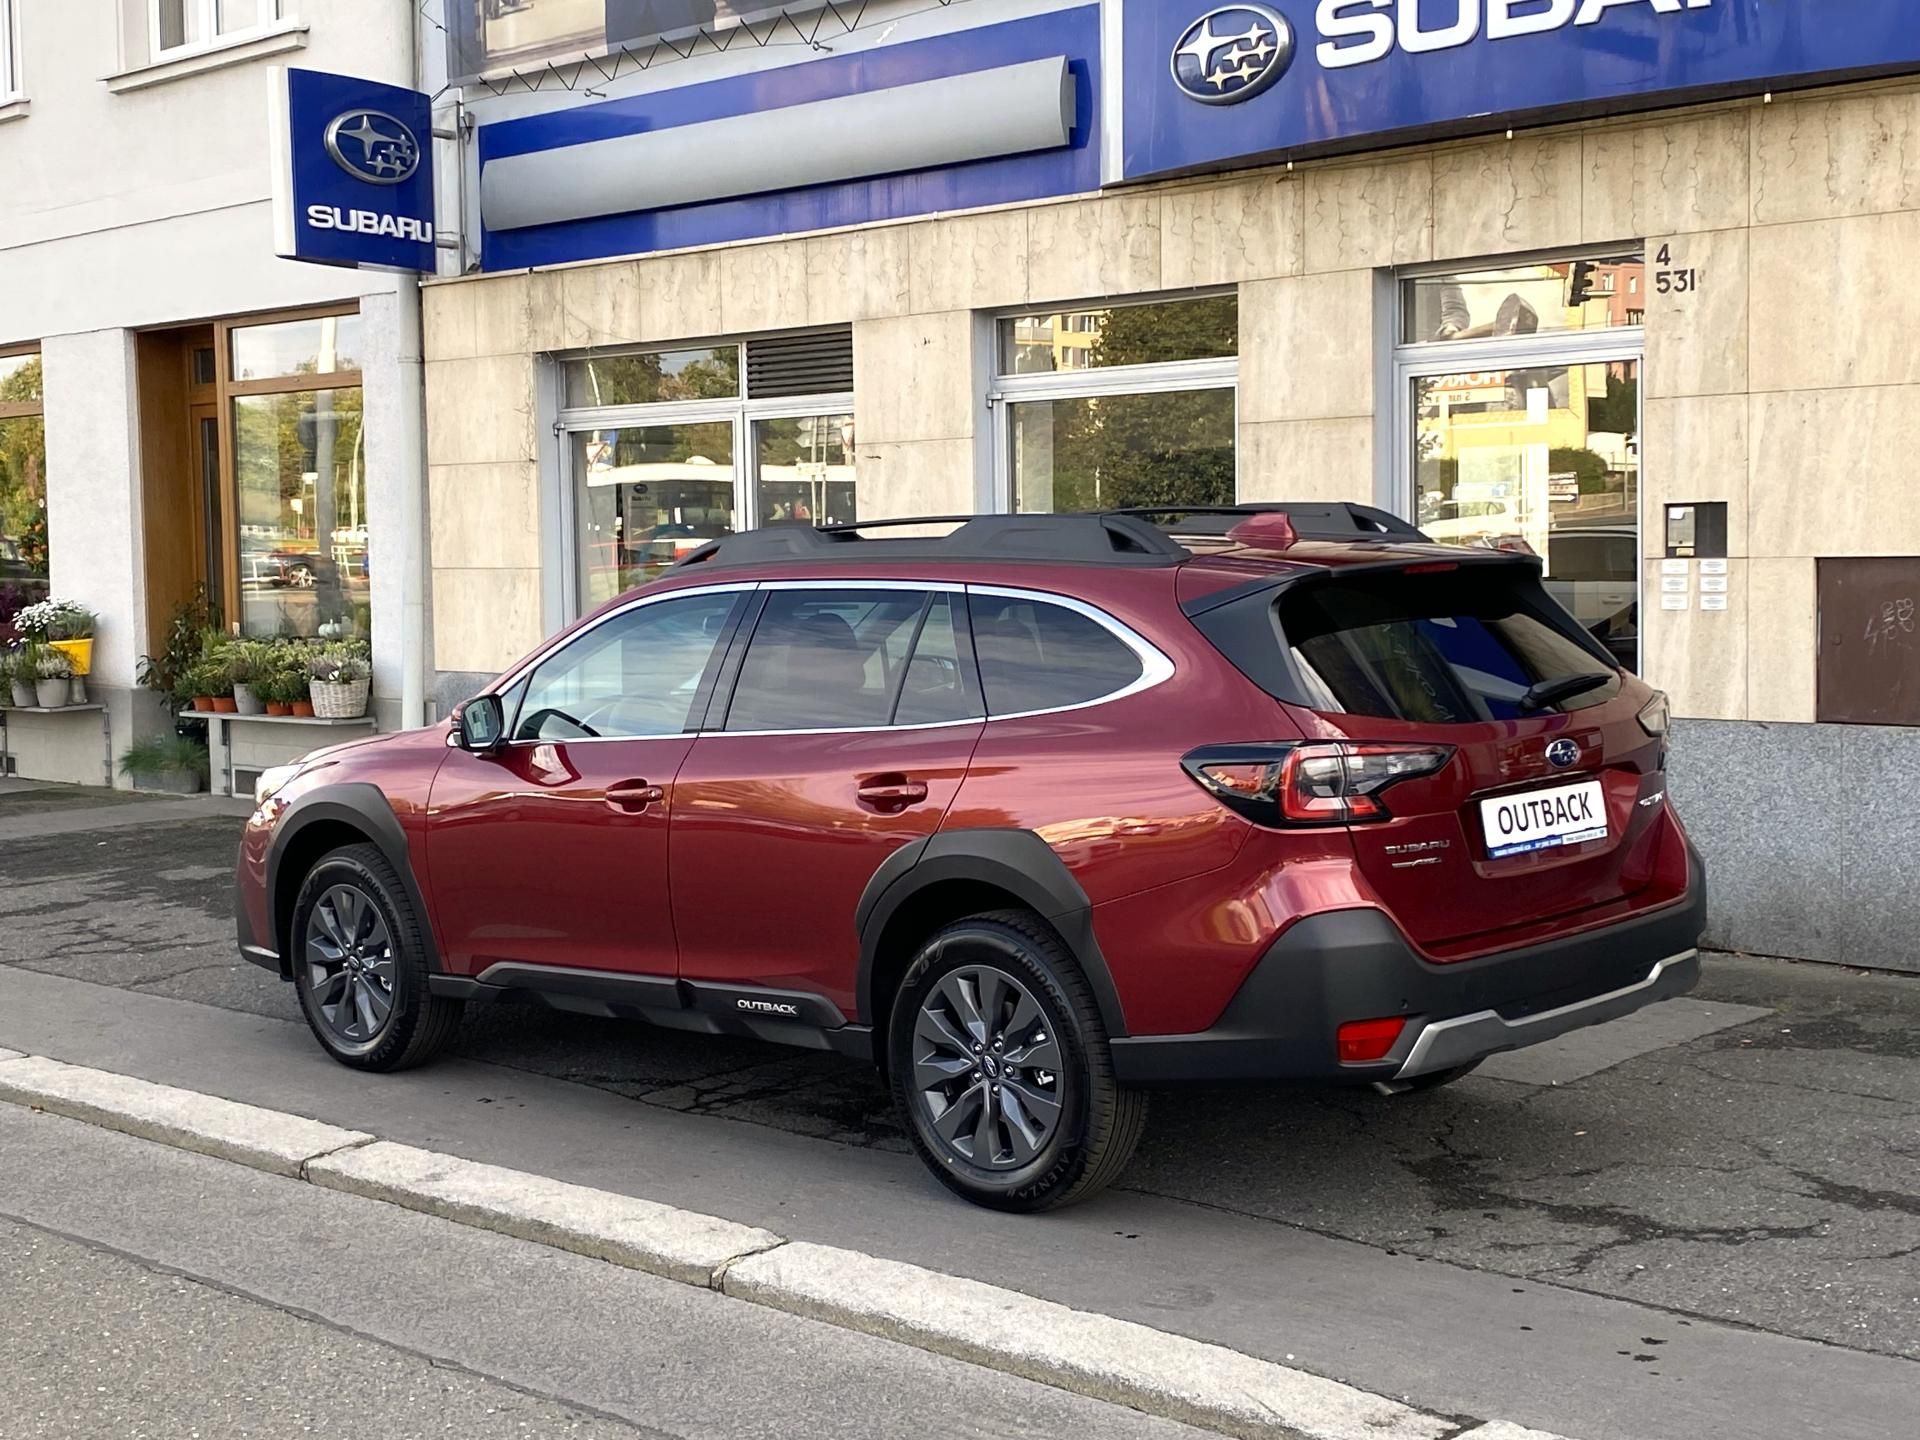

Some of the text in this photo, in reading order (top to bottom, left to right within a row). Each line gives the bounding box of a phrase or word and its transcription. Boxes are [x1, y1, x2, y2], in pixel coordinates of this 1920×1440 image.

[307, 205, 432, 242] SUBARU
[1656, 244, 1671, 266] 4
[1656, 269, 1694, 293] 531
[1498, 792, 1592, 835] OUTBACK
[1385, 840, 1450, 854] SUBARU
[737, 1000, 797, 1014] OUTBACK
